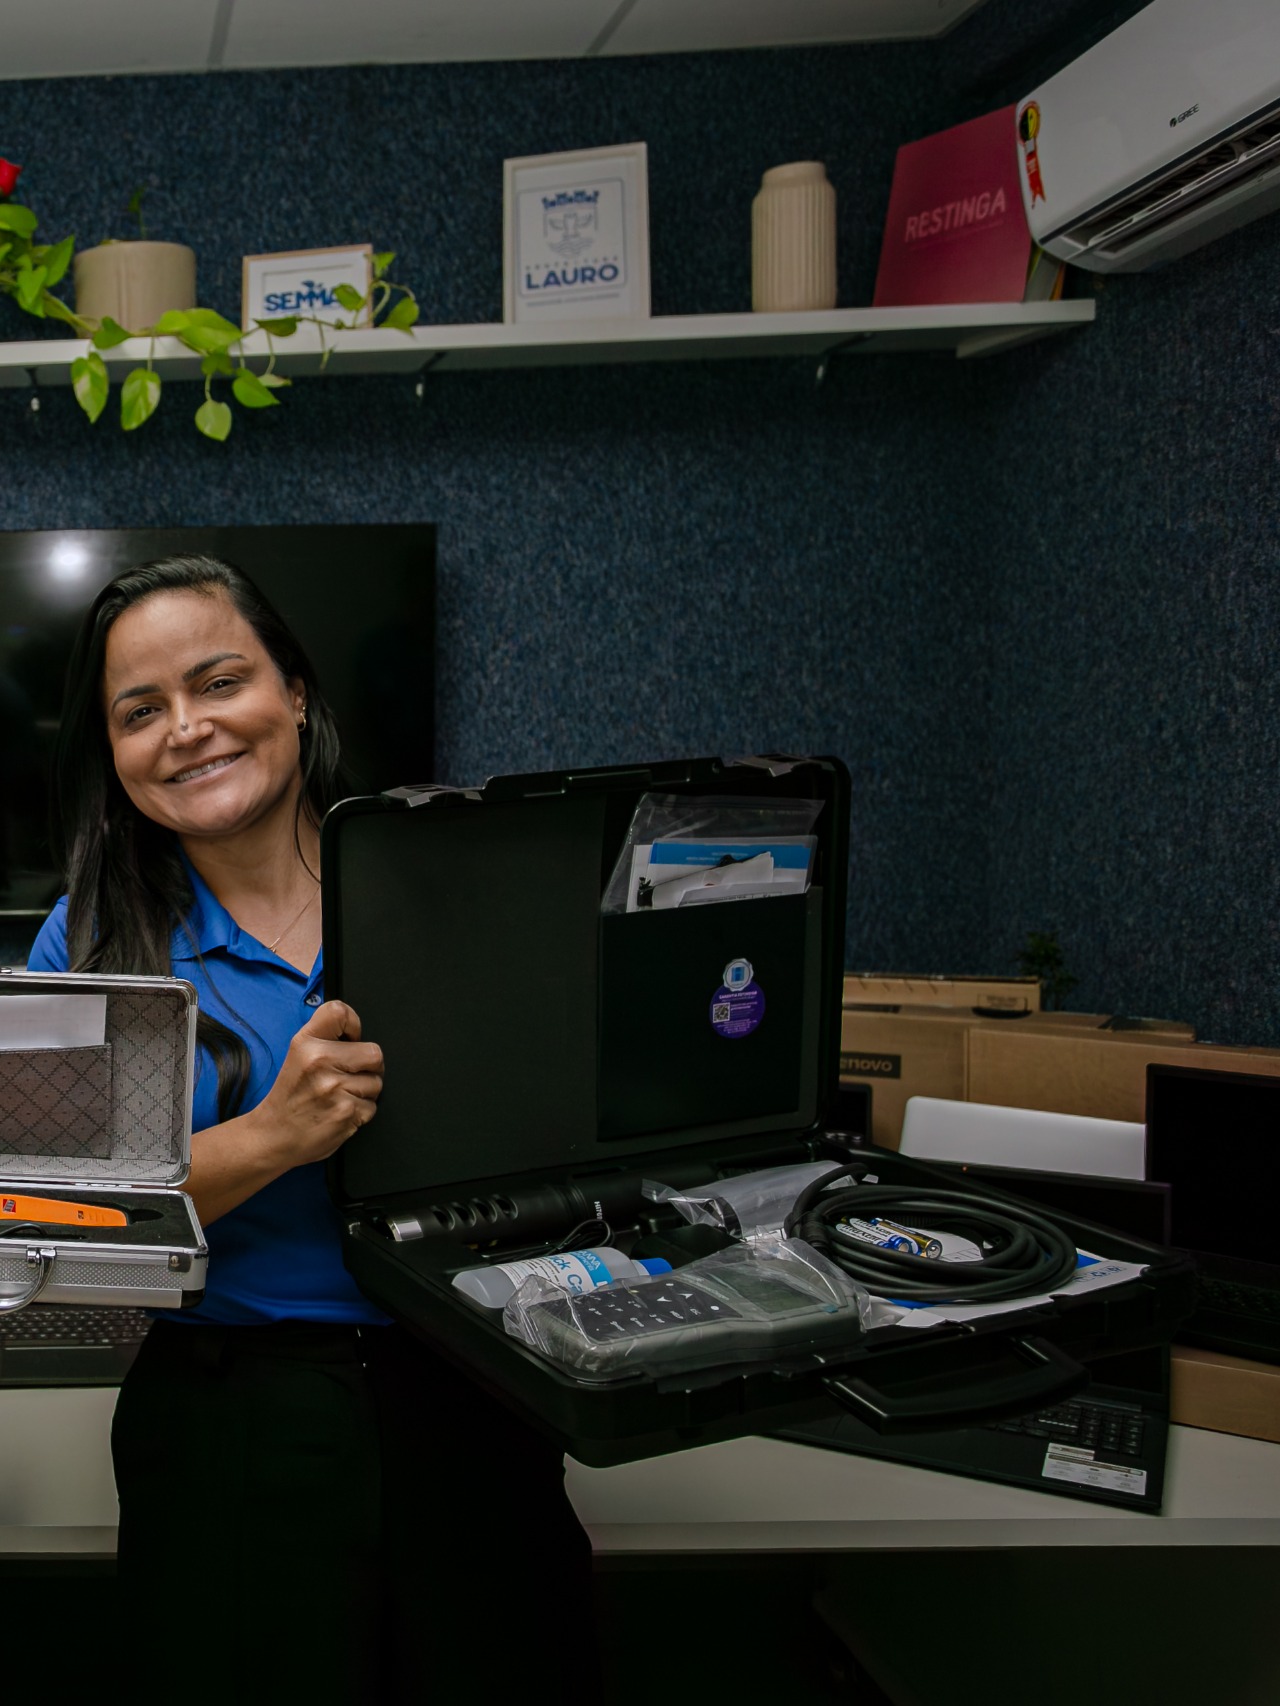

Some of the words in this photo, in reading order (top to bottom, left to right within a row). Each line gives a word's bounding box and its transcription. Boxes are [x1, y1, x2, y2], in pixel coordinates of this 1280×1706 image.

[1178, 103, 1200, 124] GREE
[904, 187, 1007, 243] RESTINGA
[526, 264, 618, 289] LAURO
[840, 1056, 893, 1072] enovo
